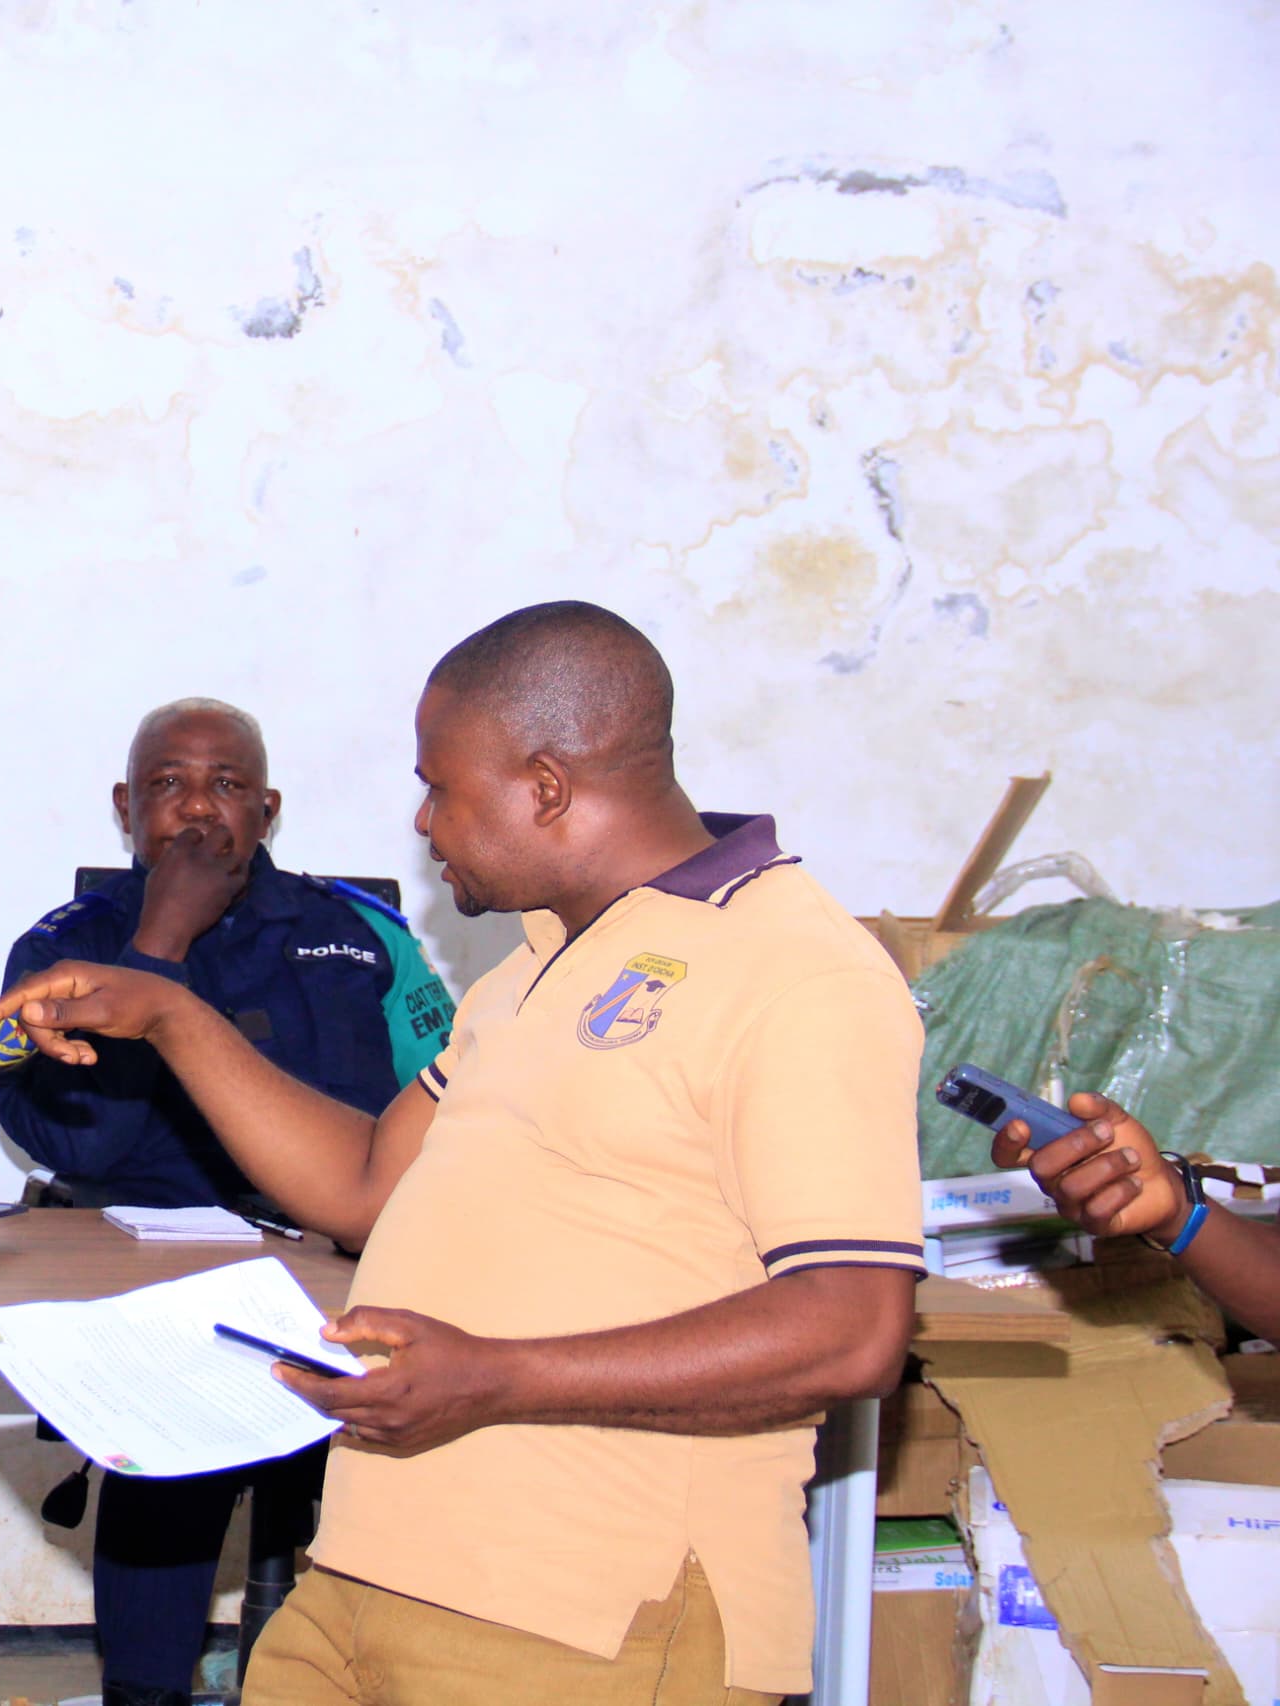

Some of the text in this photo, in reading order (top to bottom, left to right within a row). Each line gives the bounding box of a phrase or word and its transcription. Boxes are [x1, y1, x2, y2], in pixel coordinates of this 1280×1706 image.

[296, 944, 376, 964] POLICE
[410, 1007, 445, 1040] EM
[973, 1189, 1011, 1204] Solar
